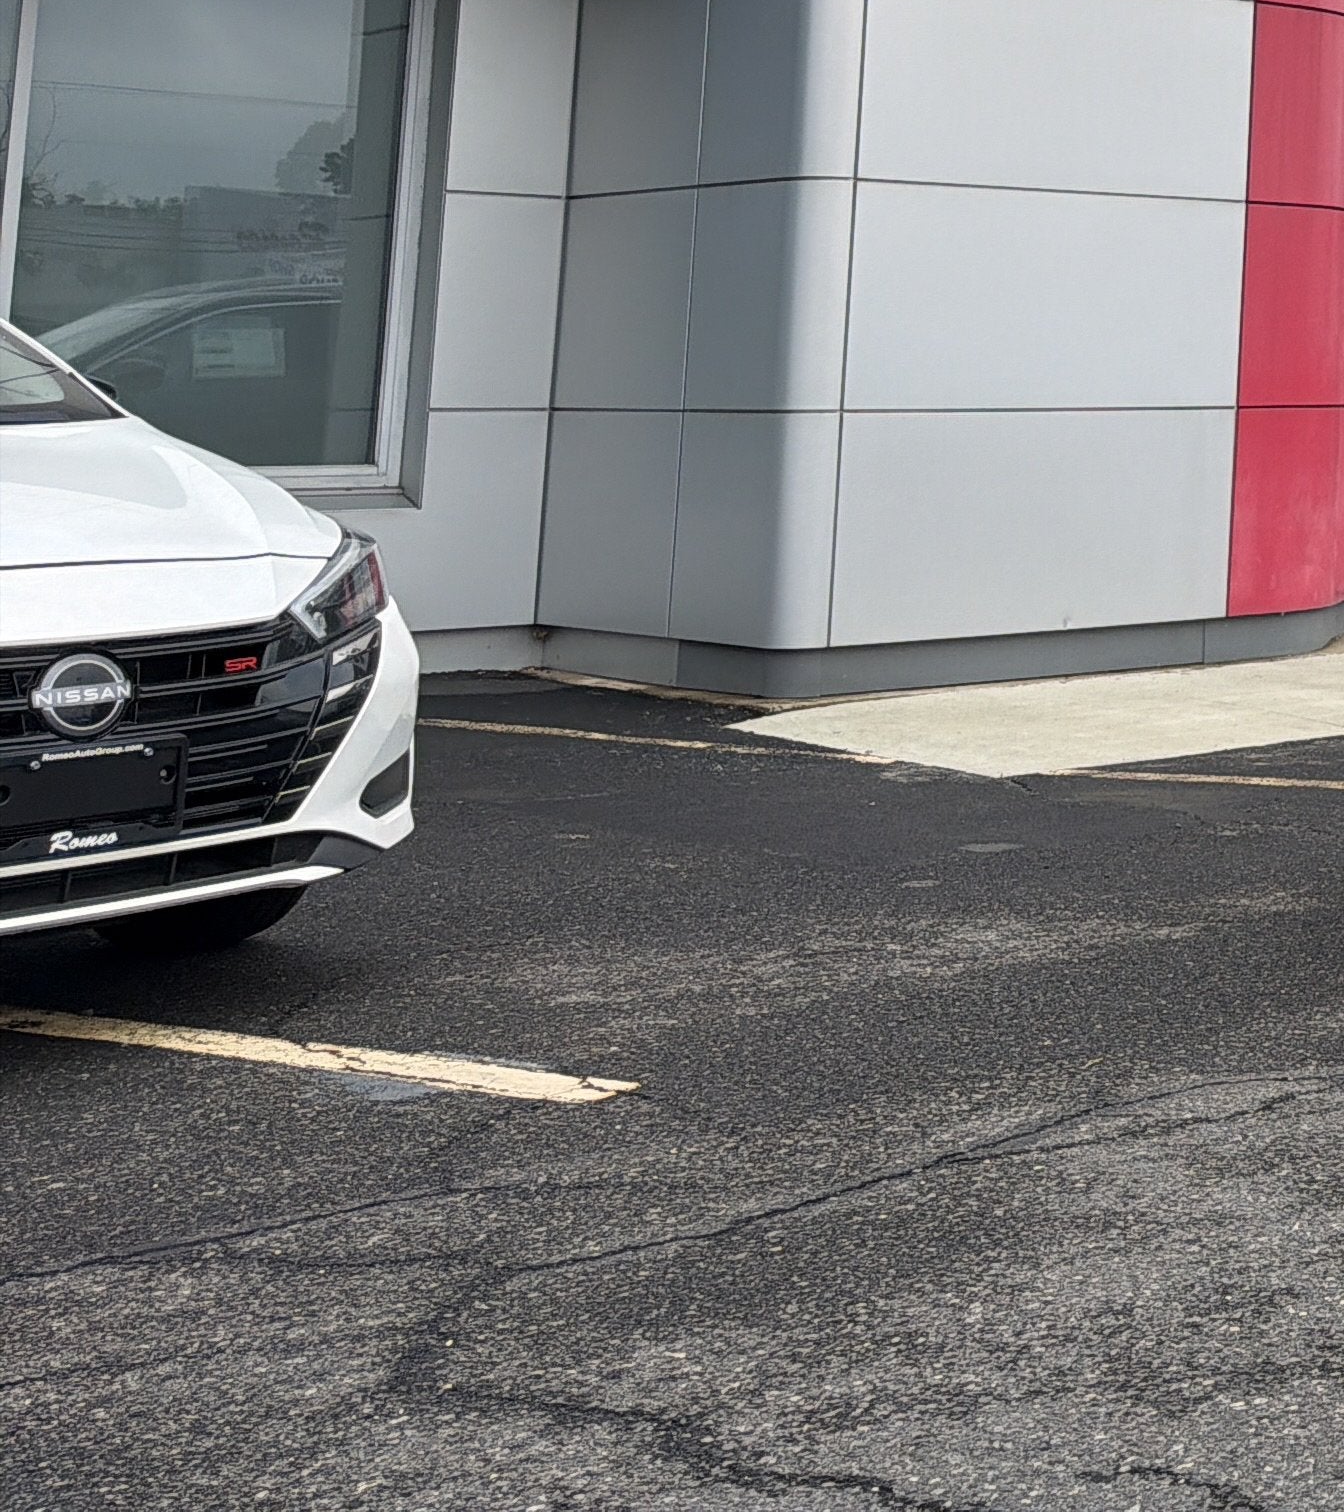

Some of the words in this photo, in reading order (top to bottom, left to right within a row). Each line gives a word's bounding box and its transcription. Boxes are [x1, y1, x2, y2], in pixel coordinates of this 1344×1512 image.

[224, 657, 258, 673] SR
[35, 679, 131, 706] NISSAN
[41, 743, 144, 762] RomeoAutoGroup.com
[48, 830, 119, 854] Romeo
